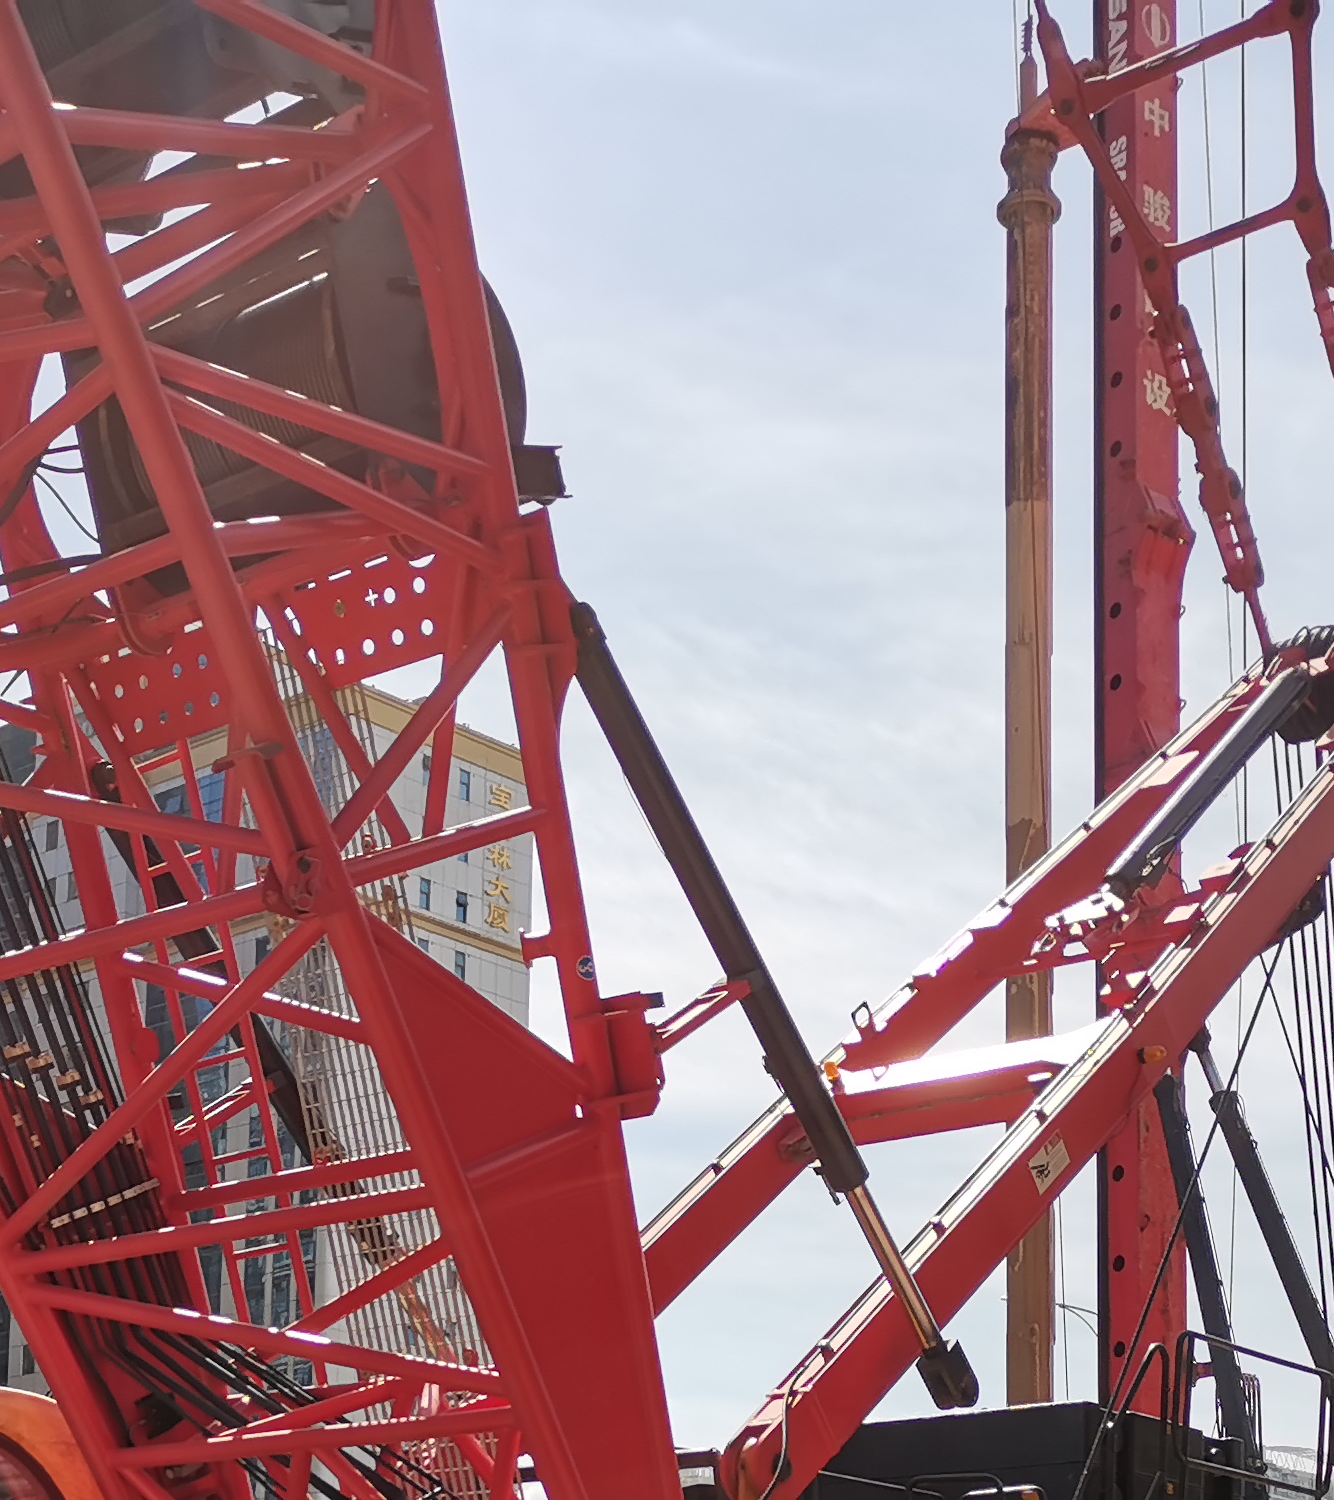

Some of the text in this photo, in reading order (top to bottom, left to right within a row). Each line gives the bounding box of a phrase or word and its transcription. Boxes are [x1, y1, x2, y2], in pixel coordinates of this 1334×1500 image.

[1108, 0, 1128, 77] SAN
[485, 783, 515, 934] 宝林大厦
